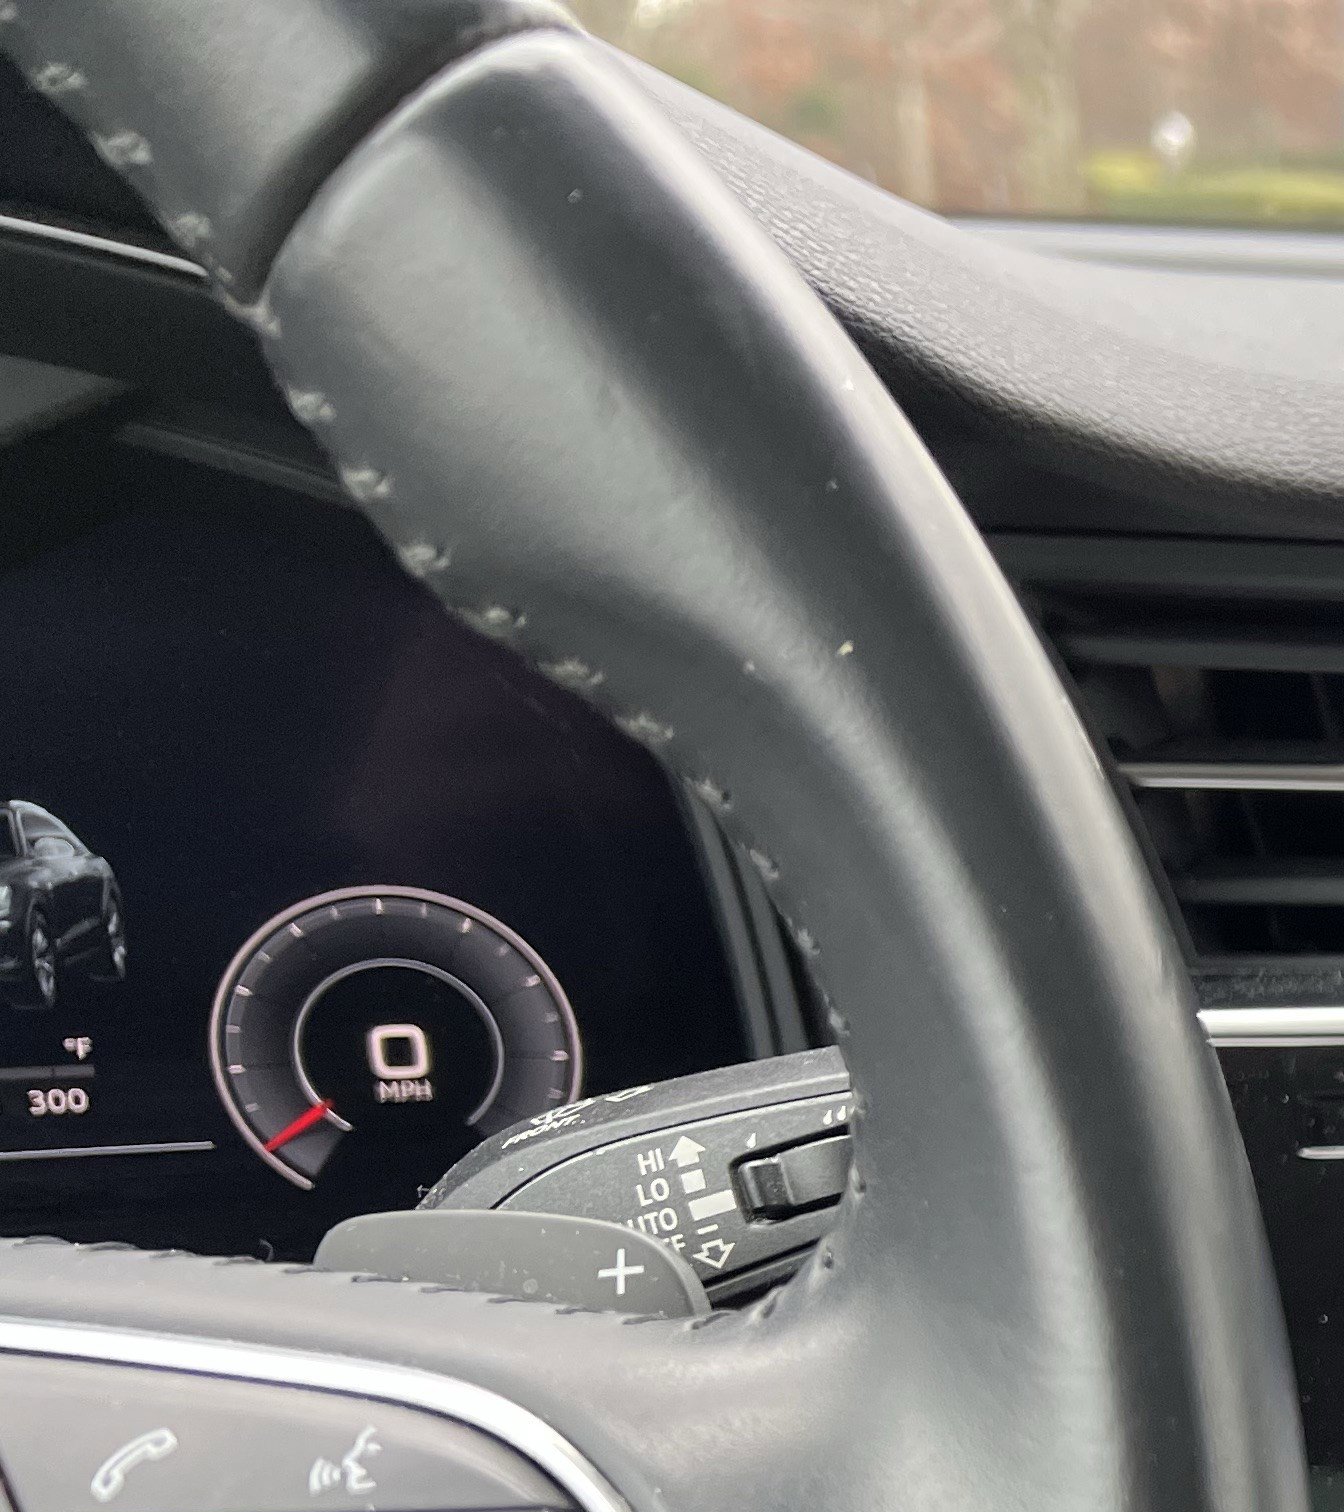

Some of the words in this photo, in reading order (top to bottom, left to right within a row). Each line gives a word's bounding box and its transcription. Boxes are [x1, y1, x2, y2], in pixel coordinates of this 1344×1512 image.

[367, 1023, 431, 1081] 0
[28, 1088, 89, 1115] 300
[377, 1080, 433, 1104] MPH
[637, 1147, 665, 1176] HI
[636, 1177, 670, 1207] LO
